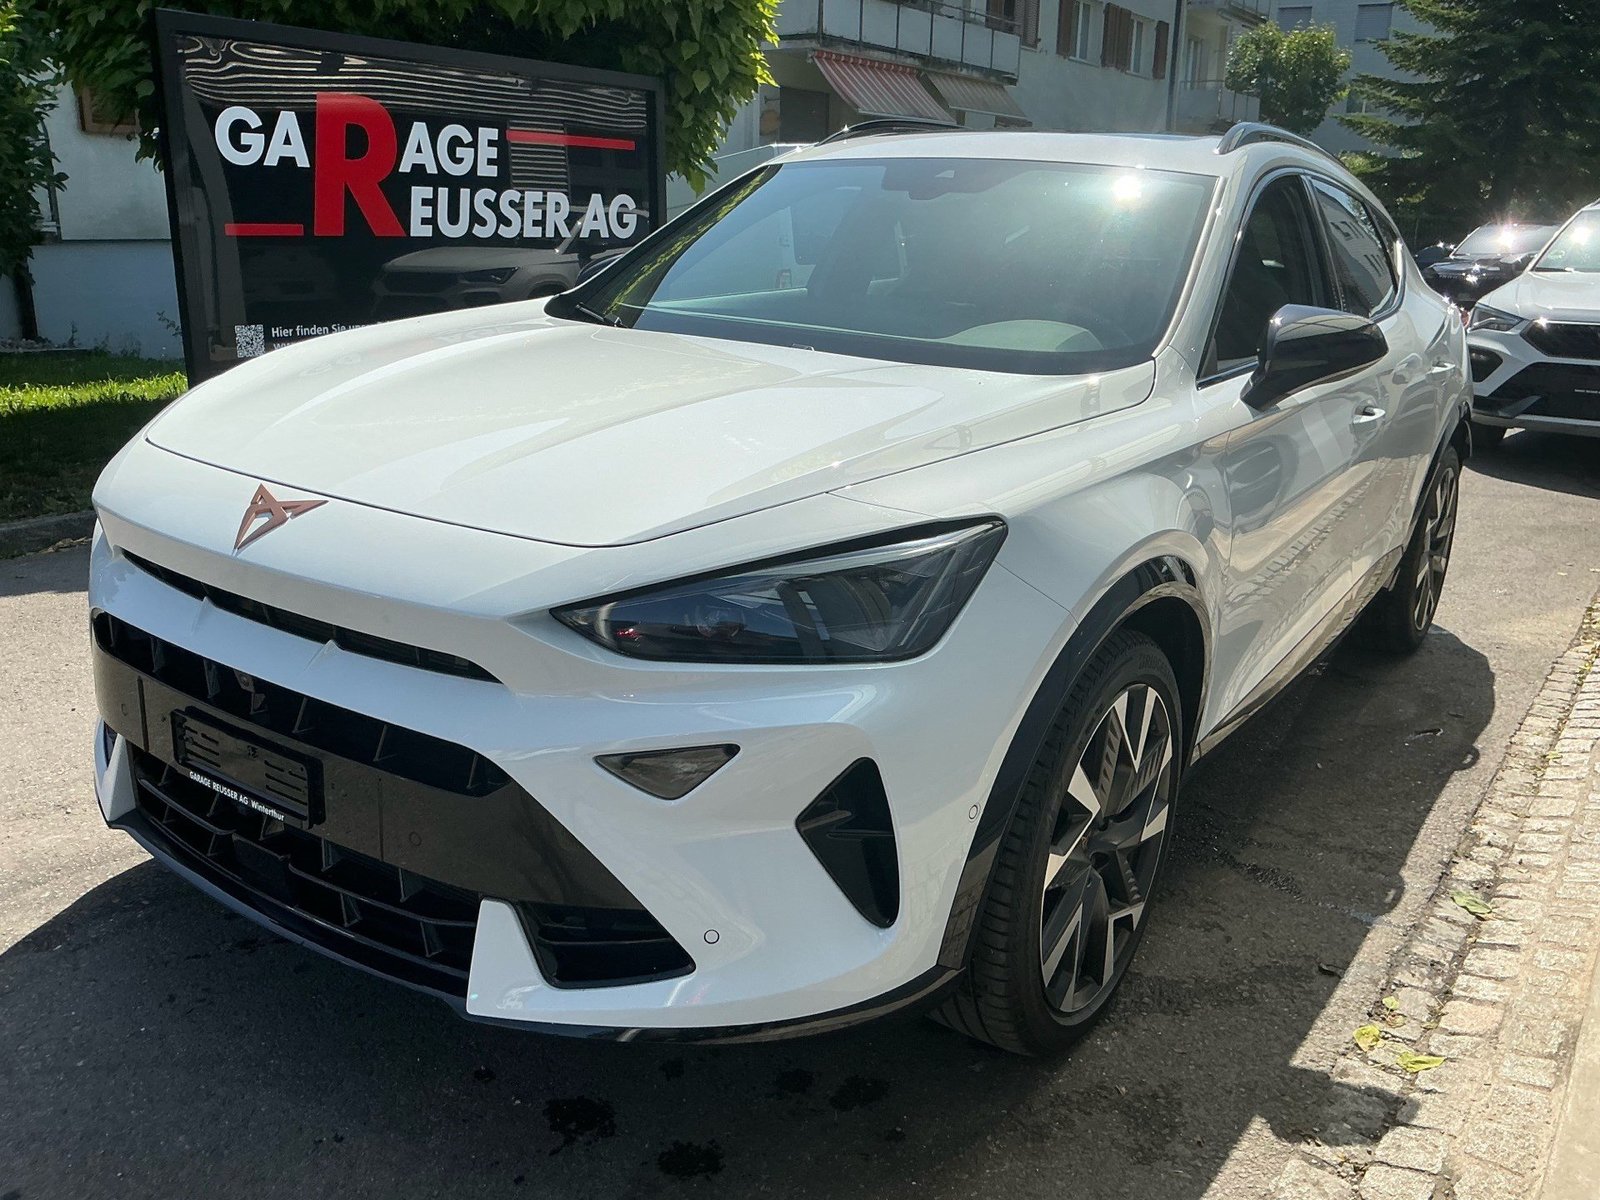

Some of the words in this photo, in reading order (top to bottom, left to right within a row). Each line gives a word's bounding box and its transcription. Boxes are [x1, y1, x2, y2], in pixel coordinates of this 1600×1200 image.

[214, 92, 499, 237] GARAGE
[579, 193, 637, 239] AG
[271, 327, 293, 338] Hier
[296, 324, 329, 337] finden
[332, 323, 346, 334] Sie
[189, 771, 211, 787] GARAGE
[212, 782, 238, 800] REUSSER
[239, 794, 249, 805] AG
[251, 800, 285, 821] Winterthur
